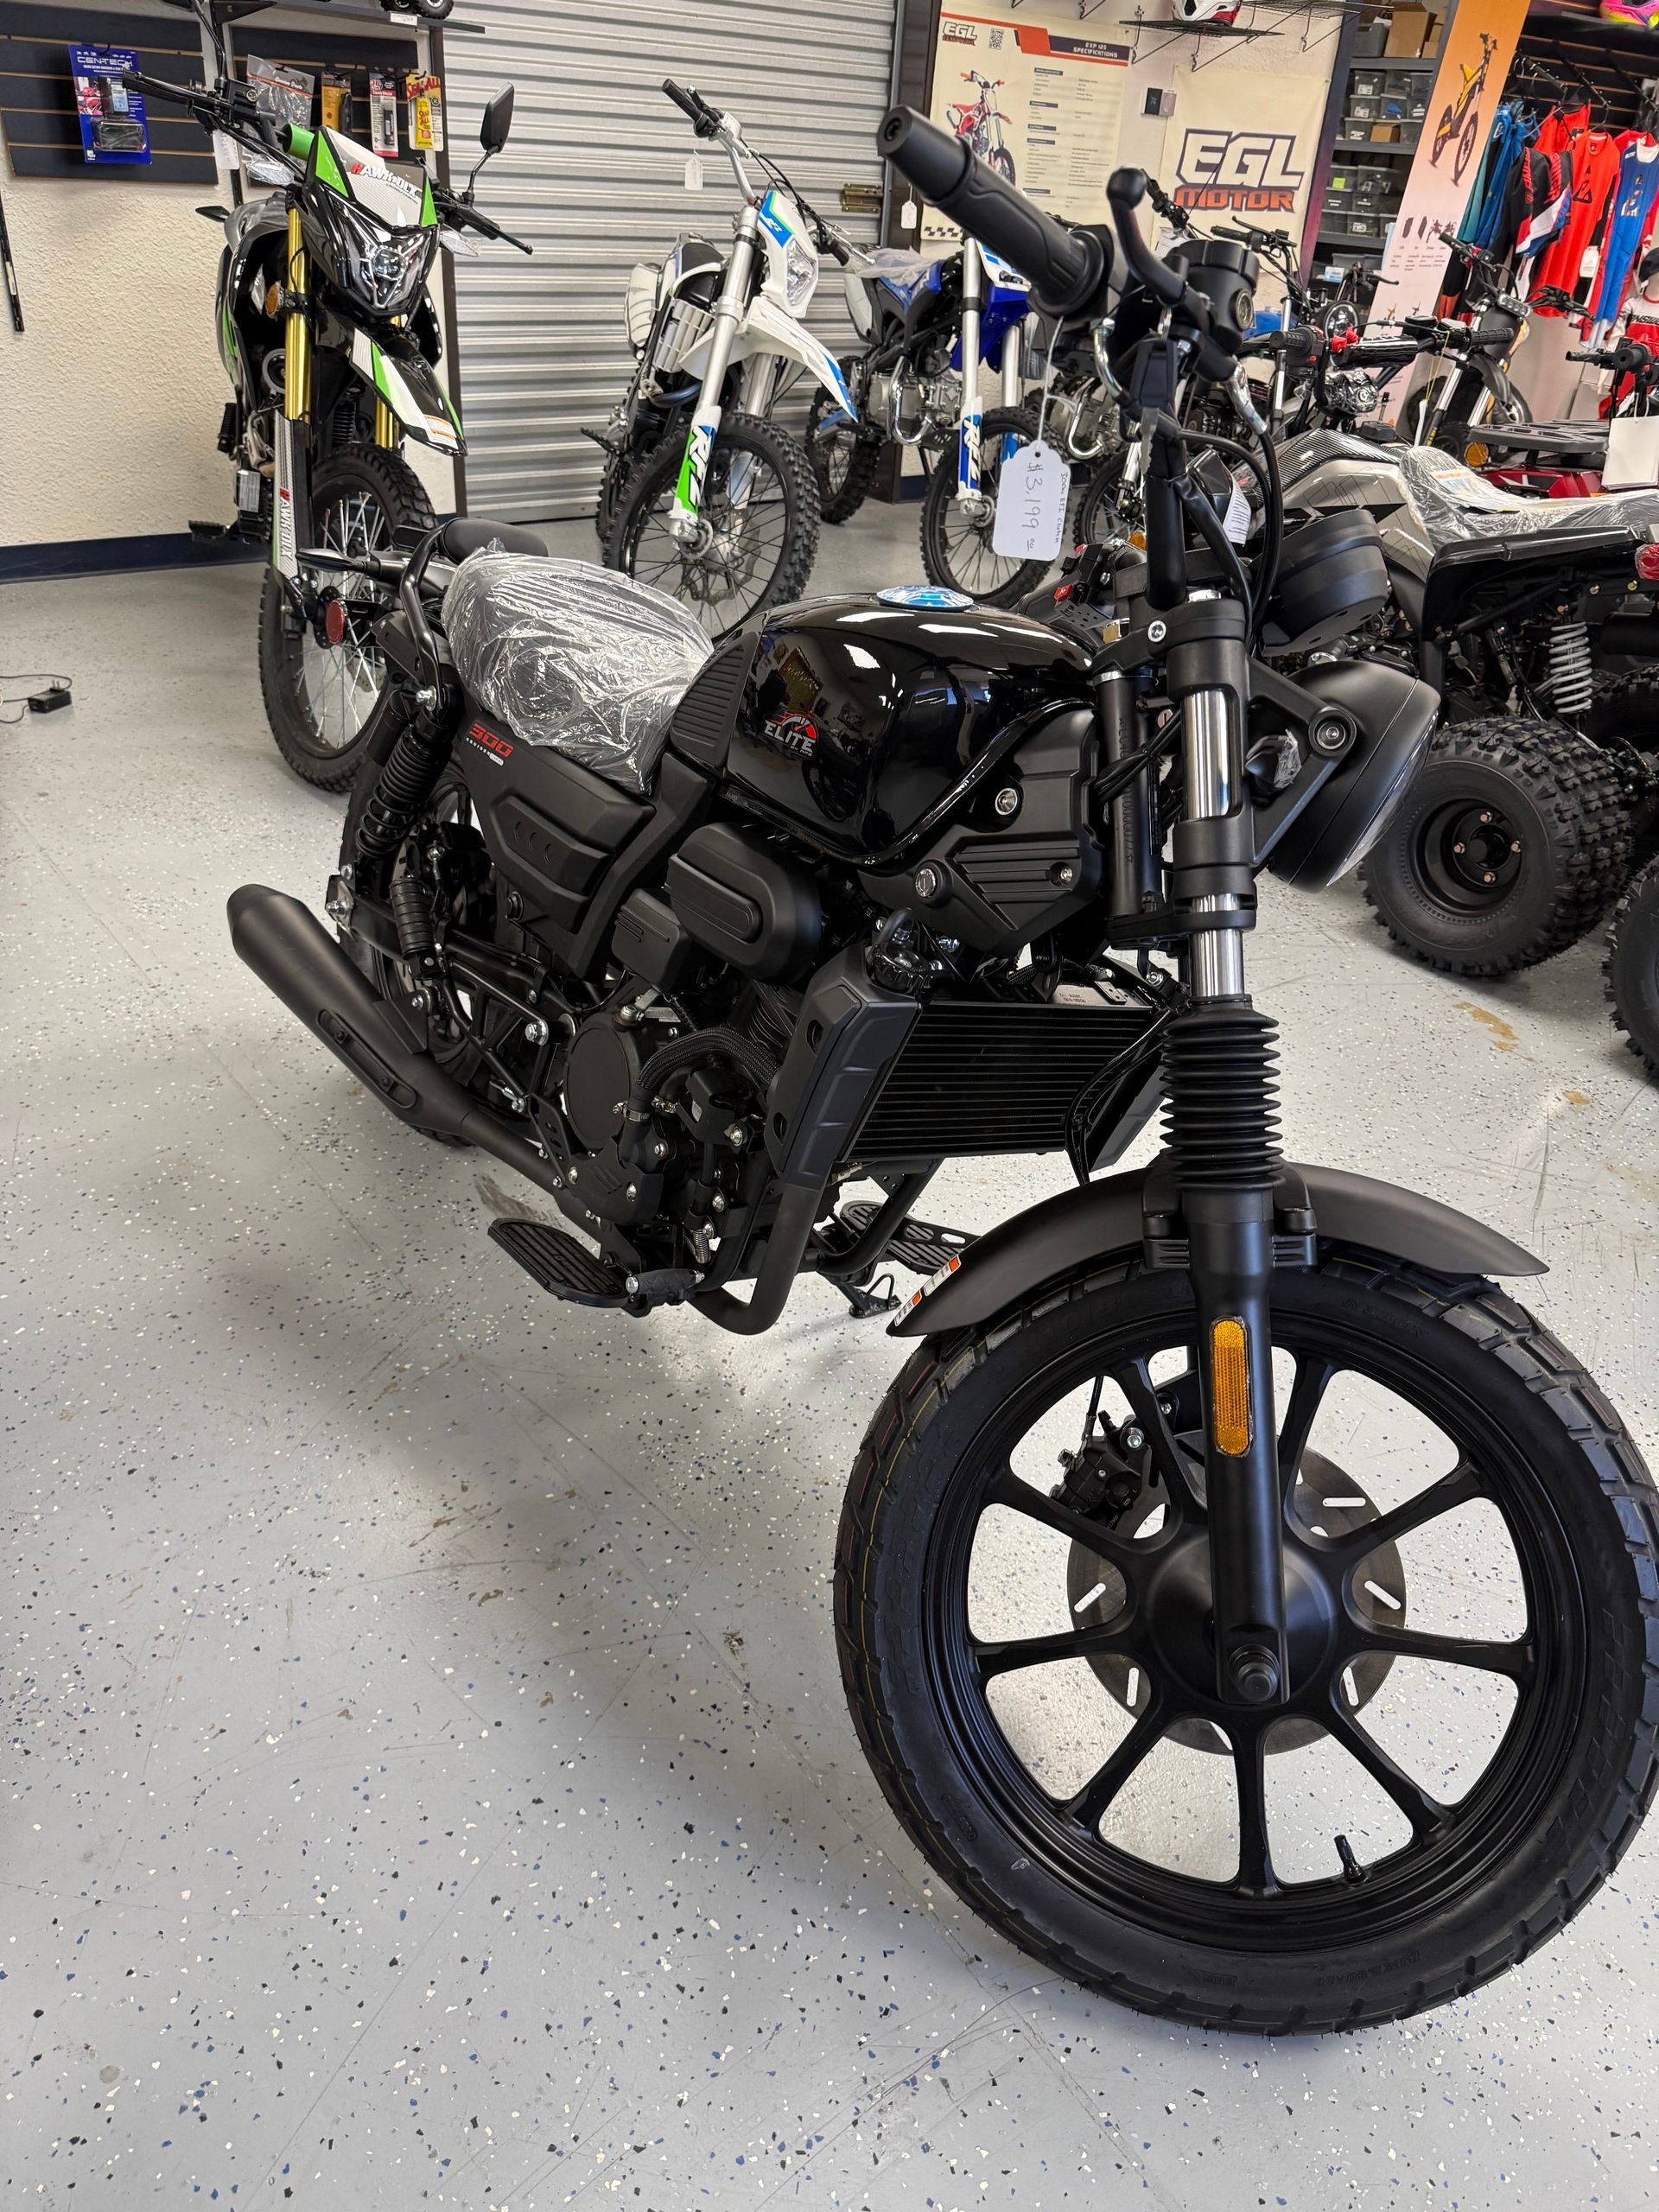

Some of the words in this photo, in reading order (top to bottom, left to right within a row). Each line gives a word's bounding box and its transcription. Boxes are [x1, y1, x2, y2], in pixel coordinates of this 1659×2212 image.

[943, 21, 977, 41] EGL
[1073, 47, 1117, 58] SPECIFICATIONS
[1176, 128, 1306, 190] EGL
[1174, 187, 1295, 213] MOTOR
[469, 722, 514, 758] 300
[764, 719, 817, 753] ELITE
